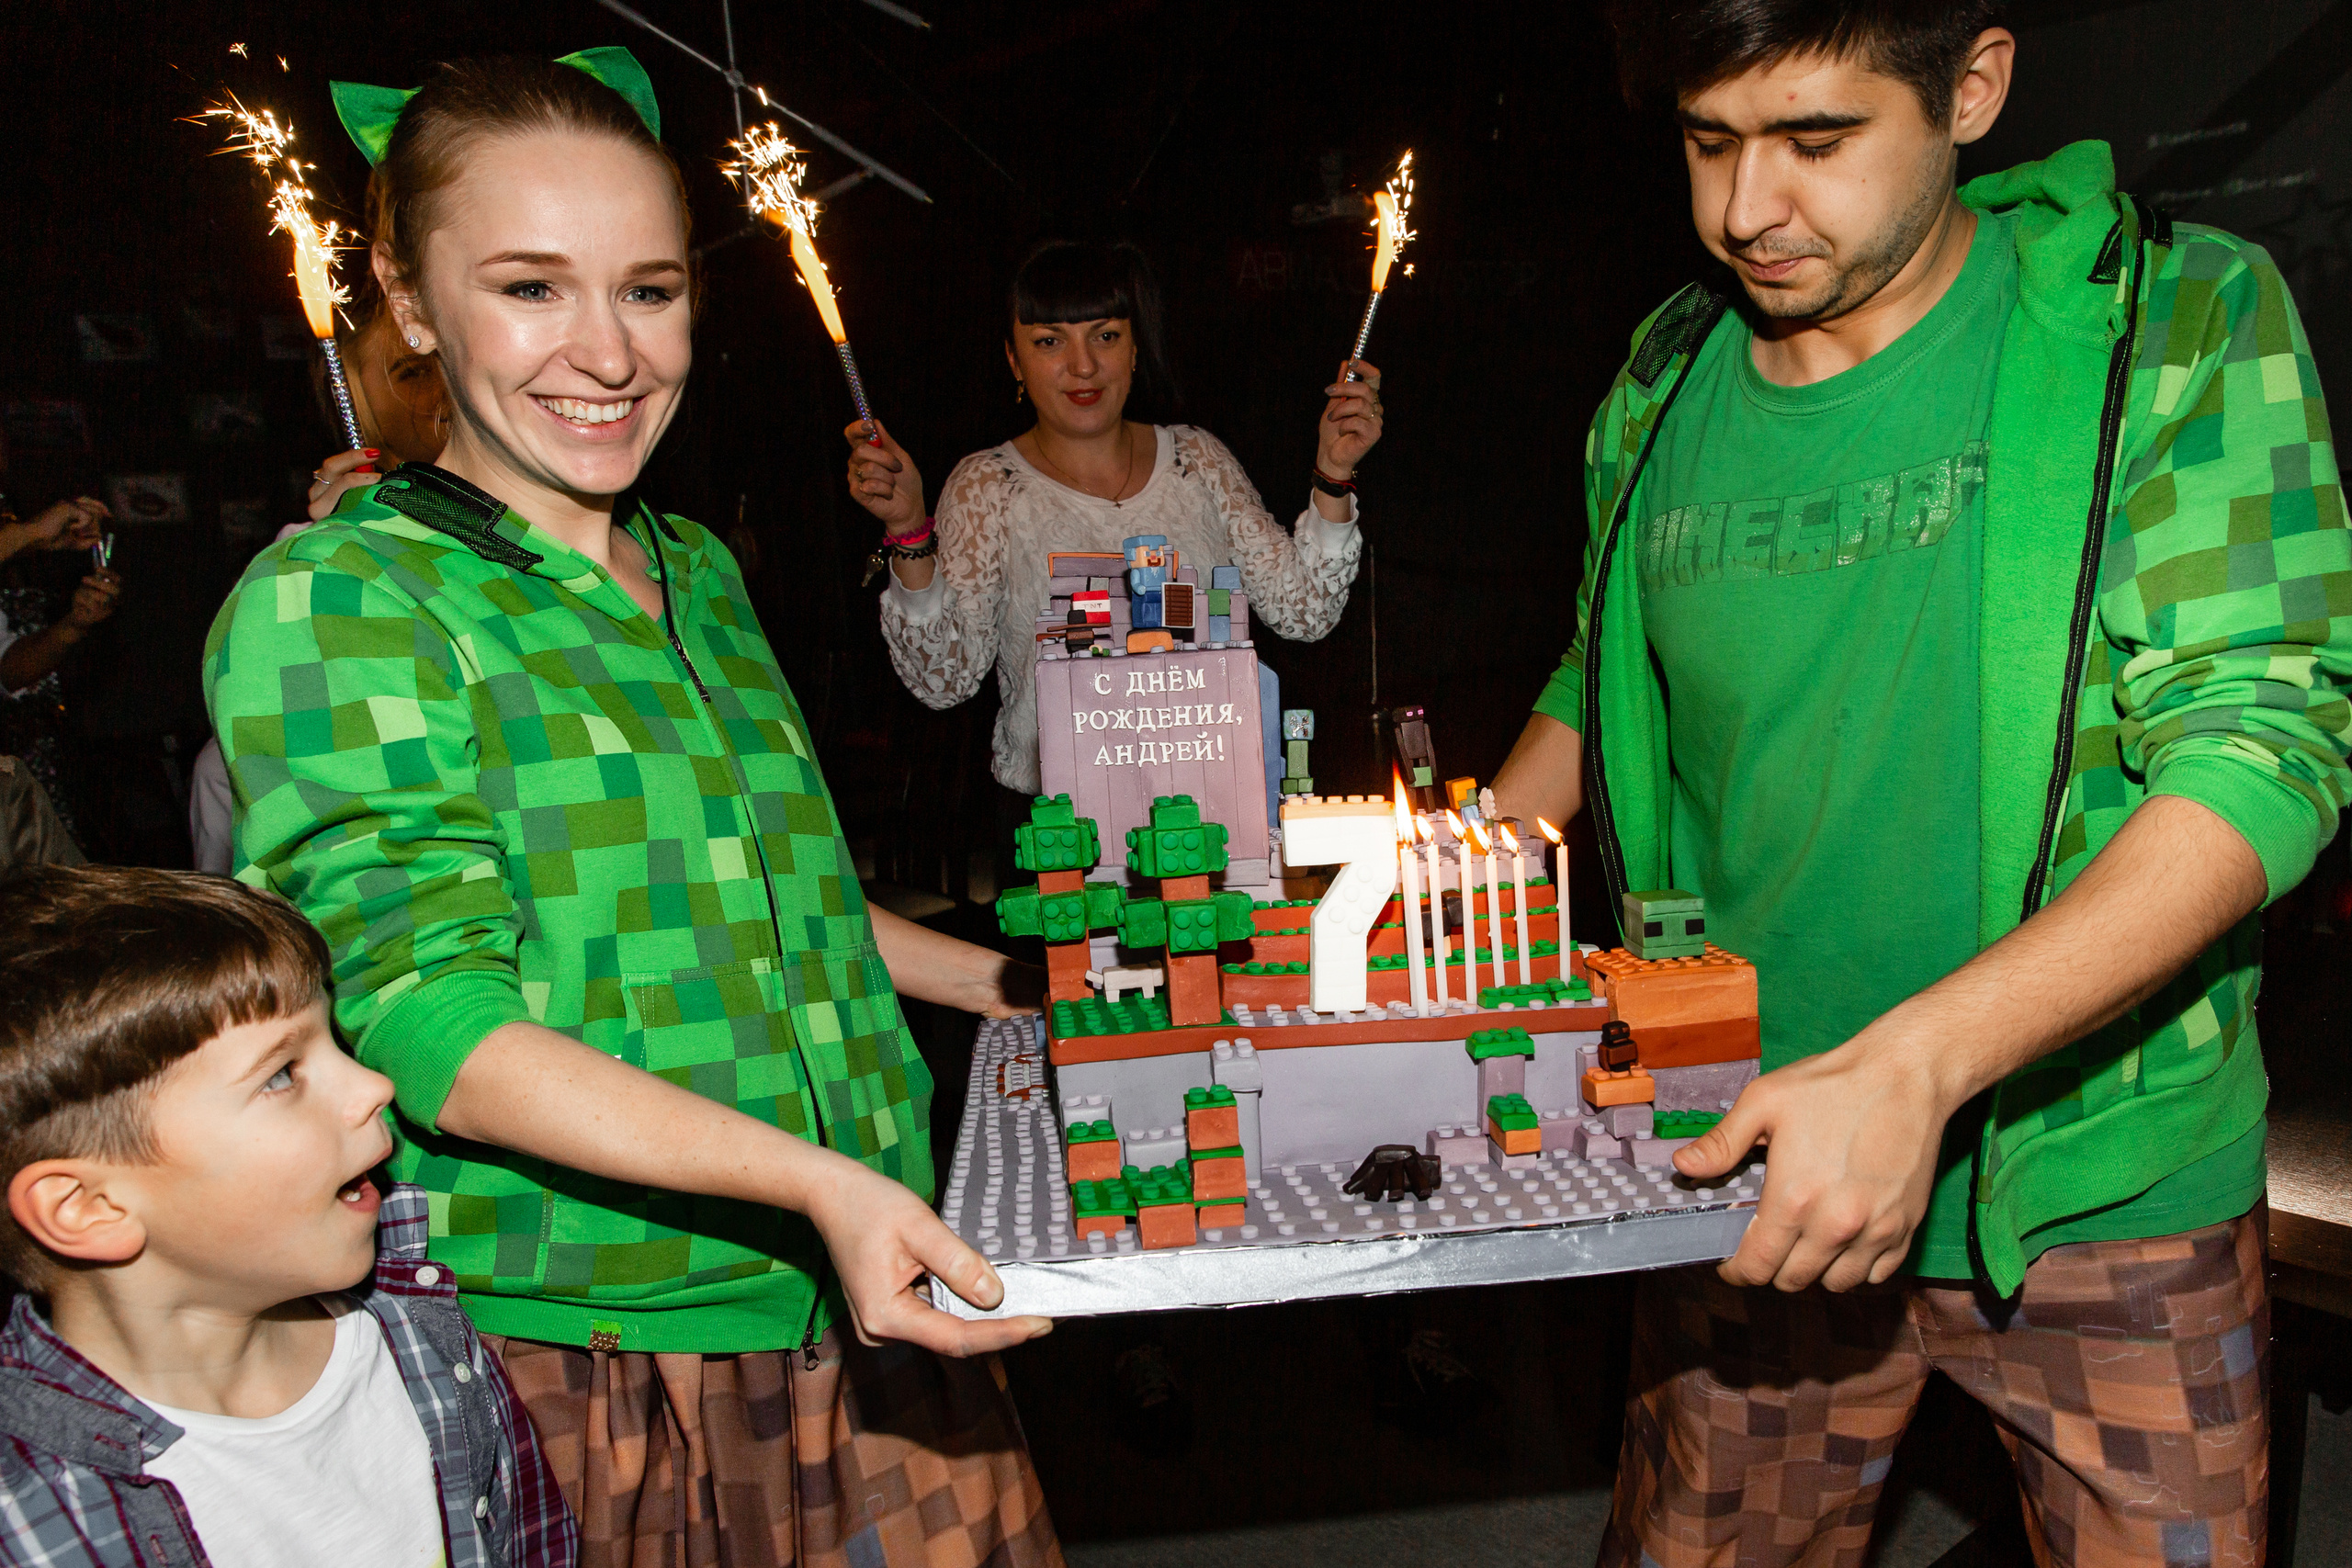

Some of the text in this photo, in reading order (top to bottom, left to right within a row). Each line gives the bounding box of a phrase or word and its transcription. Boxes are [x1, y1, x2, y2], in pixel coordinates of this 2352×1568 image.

[1636, 439, 1989, 592] MINECRAF
[1094, 665, 1206, 697] С ДНЁМ
[1072, 703, 1243, 734] РОЖДЕНИЯ,
[1094, 731, 1225, 767] АНДРЕЙ!
[1280, 795, 1397, 1013] 7
